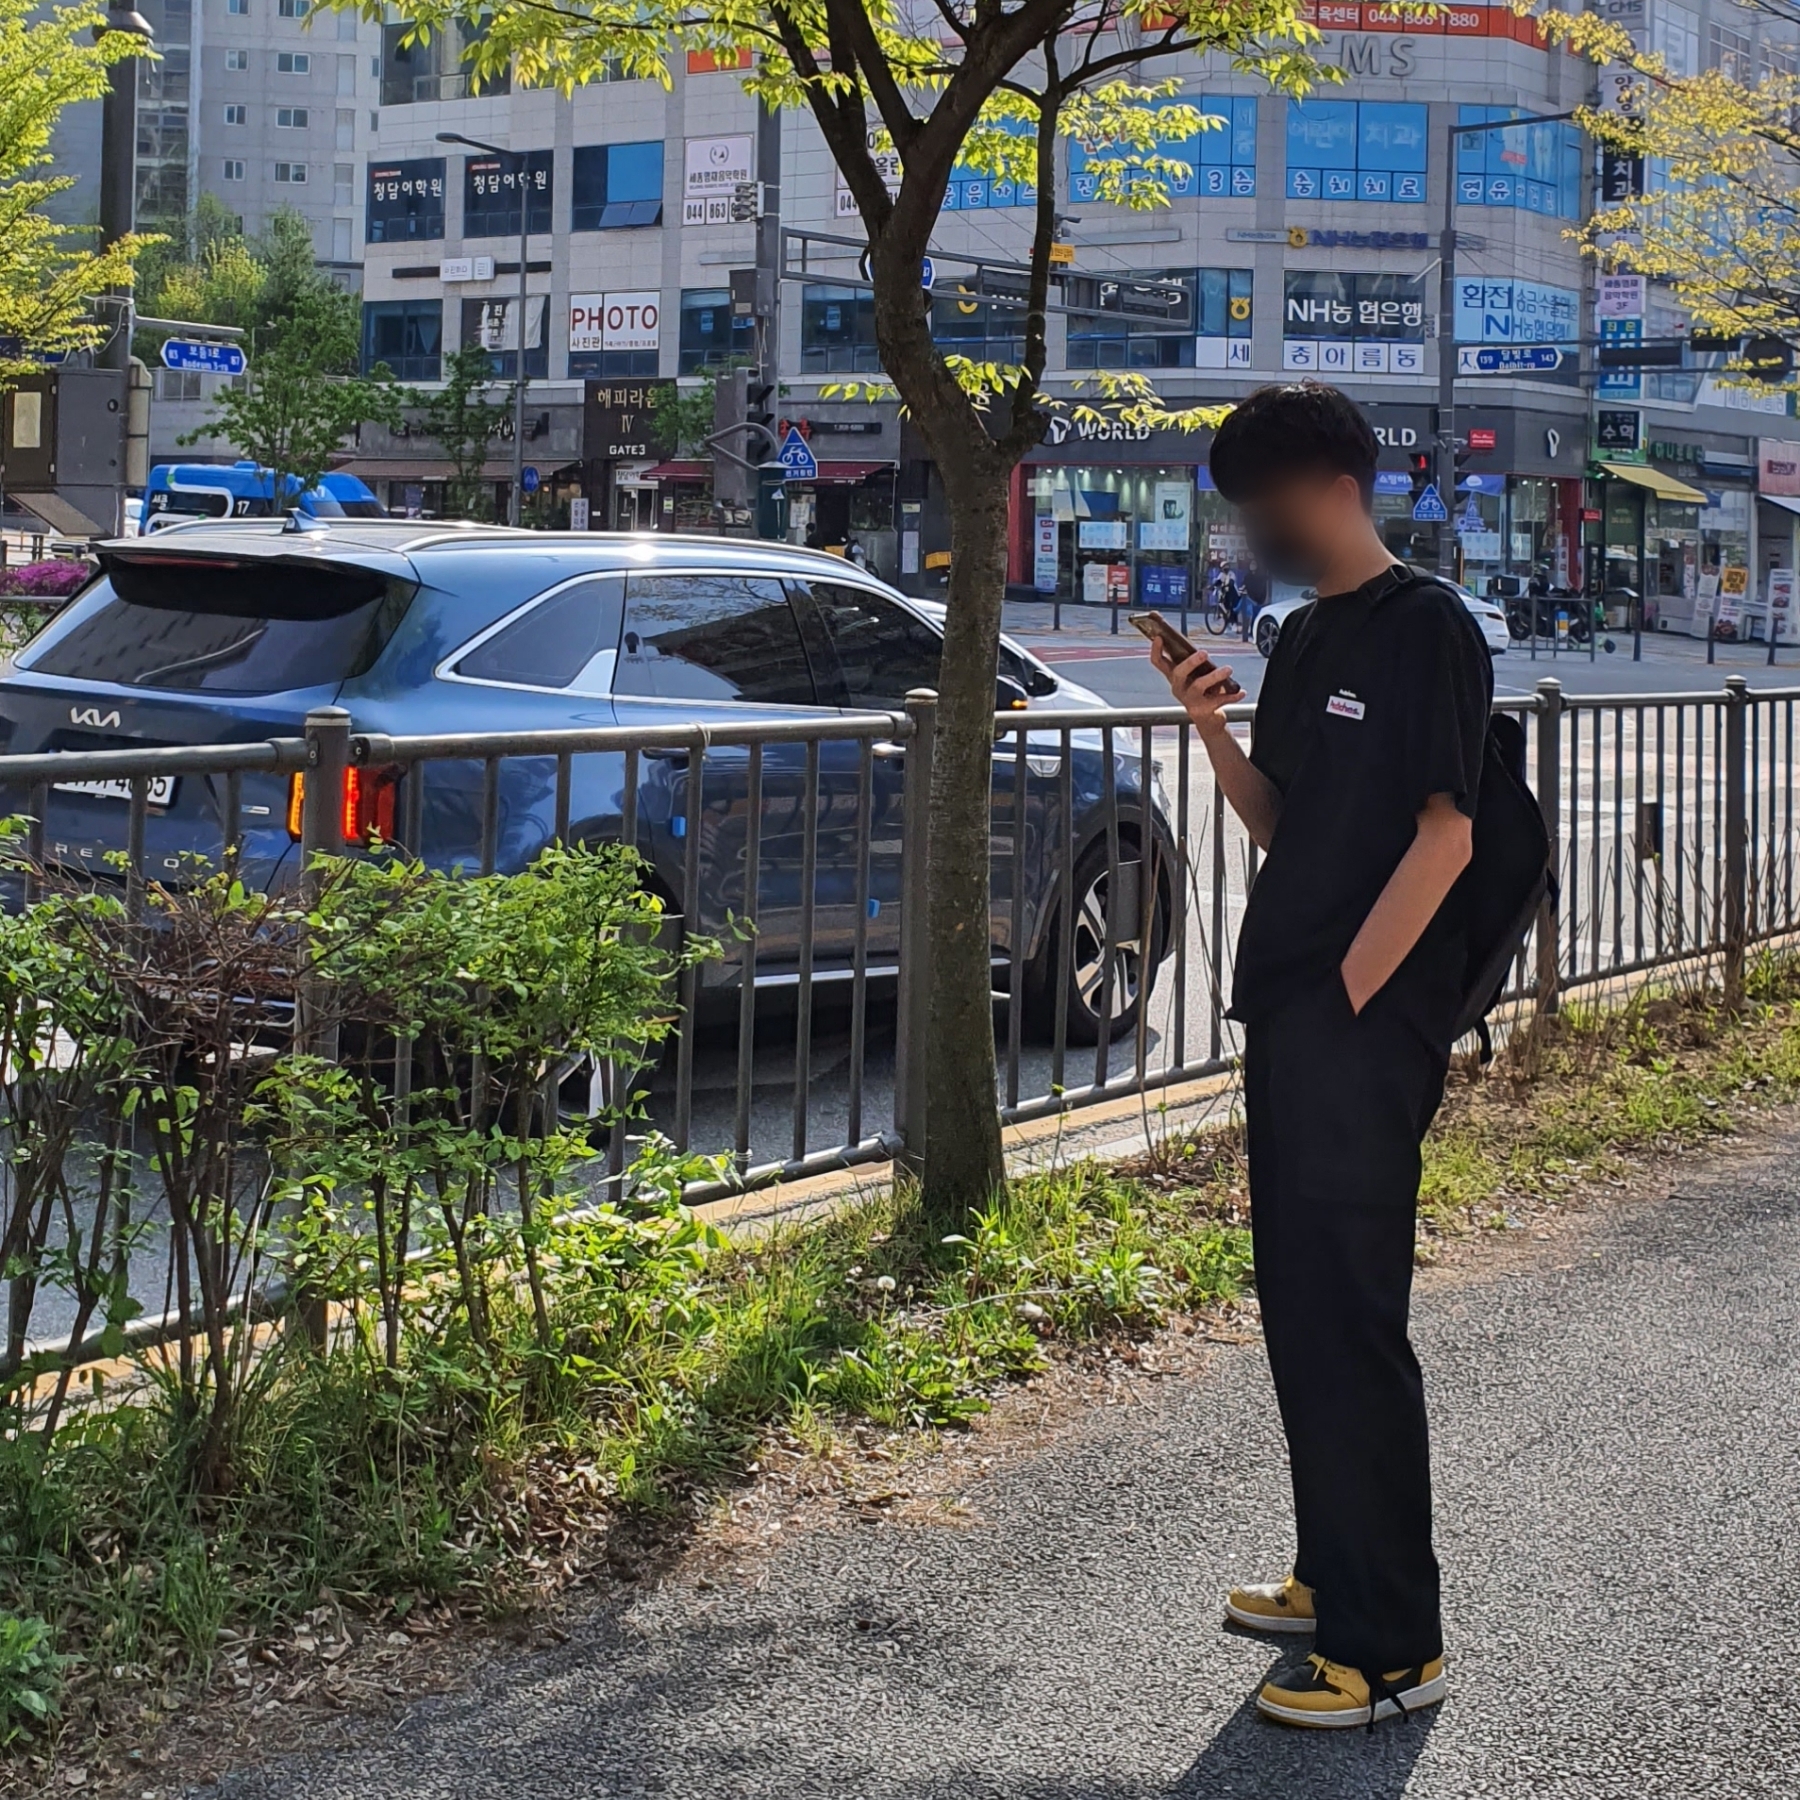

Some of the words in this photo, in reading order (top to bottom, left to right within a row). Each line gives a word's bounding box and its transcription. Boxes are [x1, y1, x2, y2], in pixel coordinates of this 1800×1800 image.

[1297, 5, 1360, 24] 교육센터
[1612, 160, 1635, 197] 치과
[373, 178, 443, 202] 청담어학원
[686, 204, 703, 220] 044
[709, 202, 726, 219] 863
[1461, 283, 1513, 310] 환전
[571, 304, 658, 332] PHOTO
[1288, 299, 1422, 327] NH농협은행
[572, 336, 600, 349] 사진관
[1480, 354, 1494, 365] 139
[1500, 348, 1533, 361] 달빛로
[1541, 353, 1555, 363] 143
[1078, 421, 1151, 441] WORLD
[1373, 427, 1417, 446] RLD
[237, 500, 250, 515] 17
[69, 706, 122, 728] KIA
